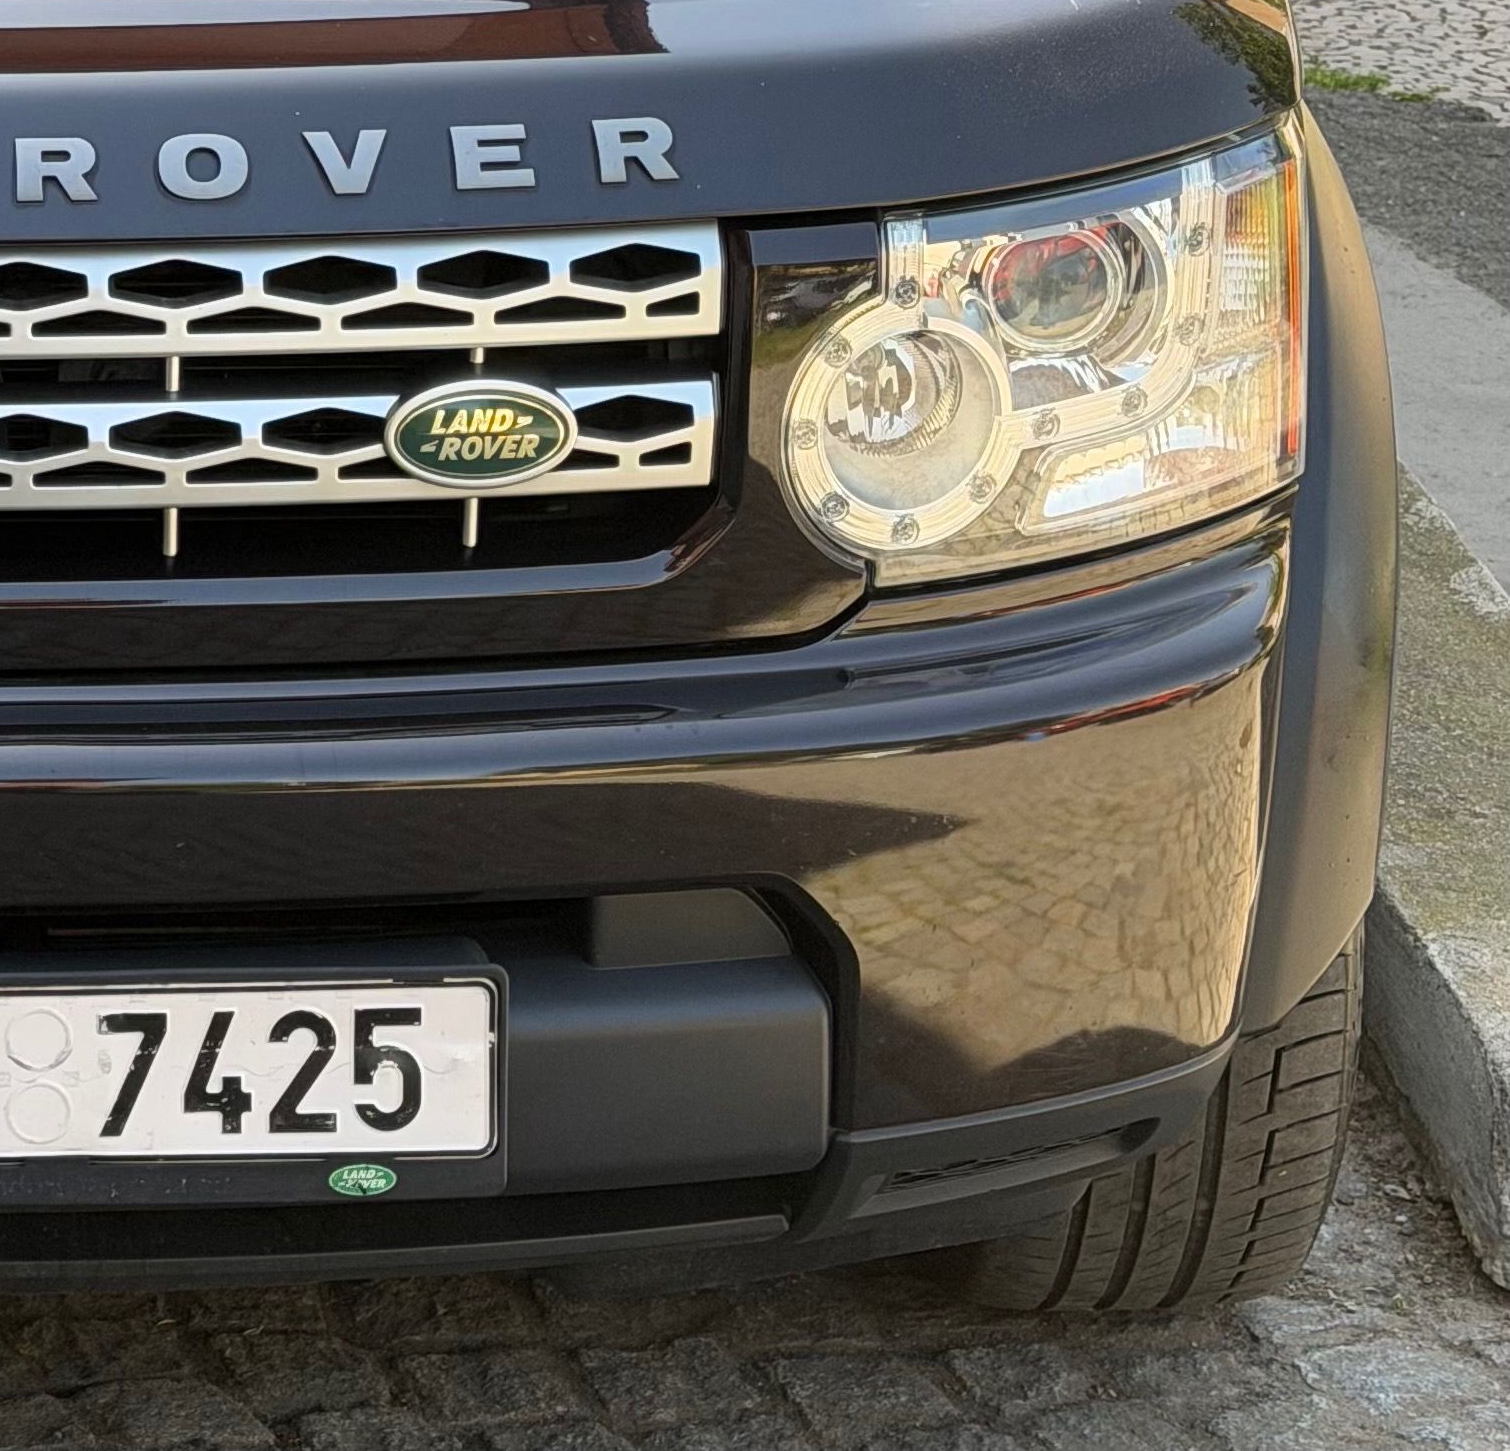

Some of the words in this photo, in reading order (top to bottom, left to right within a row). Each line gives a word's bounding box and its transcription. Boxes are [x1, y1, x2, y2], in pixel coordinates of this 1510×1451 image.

[15, 116, 680, 203] ROVER
[430, 408, 515, 435] LAND
[438, 433, 540, 461] ROVER
[97, 1007, 422, 1137] 7425
[342, 1169, 376, 1179] LAND
